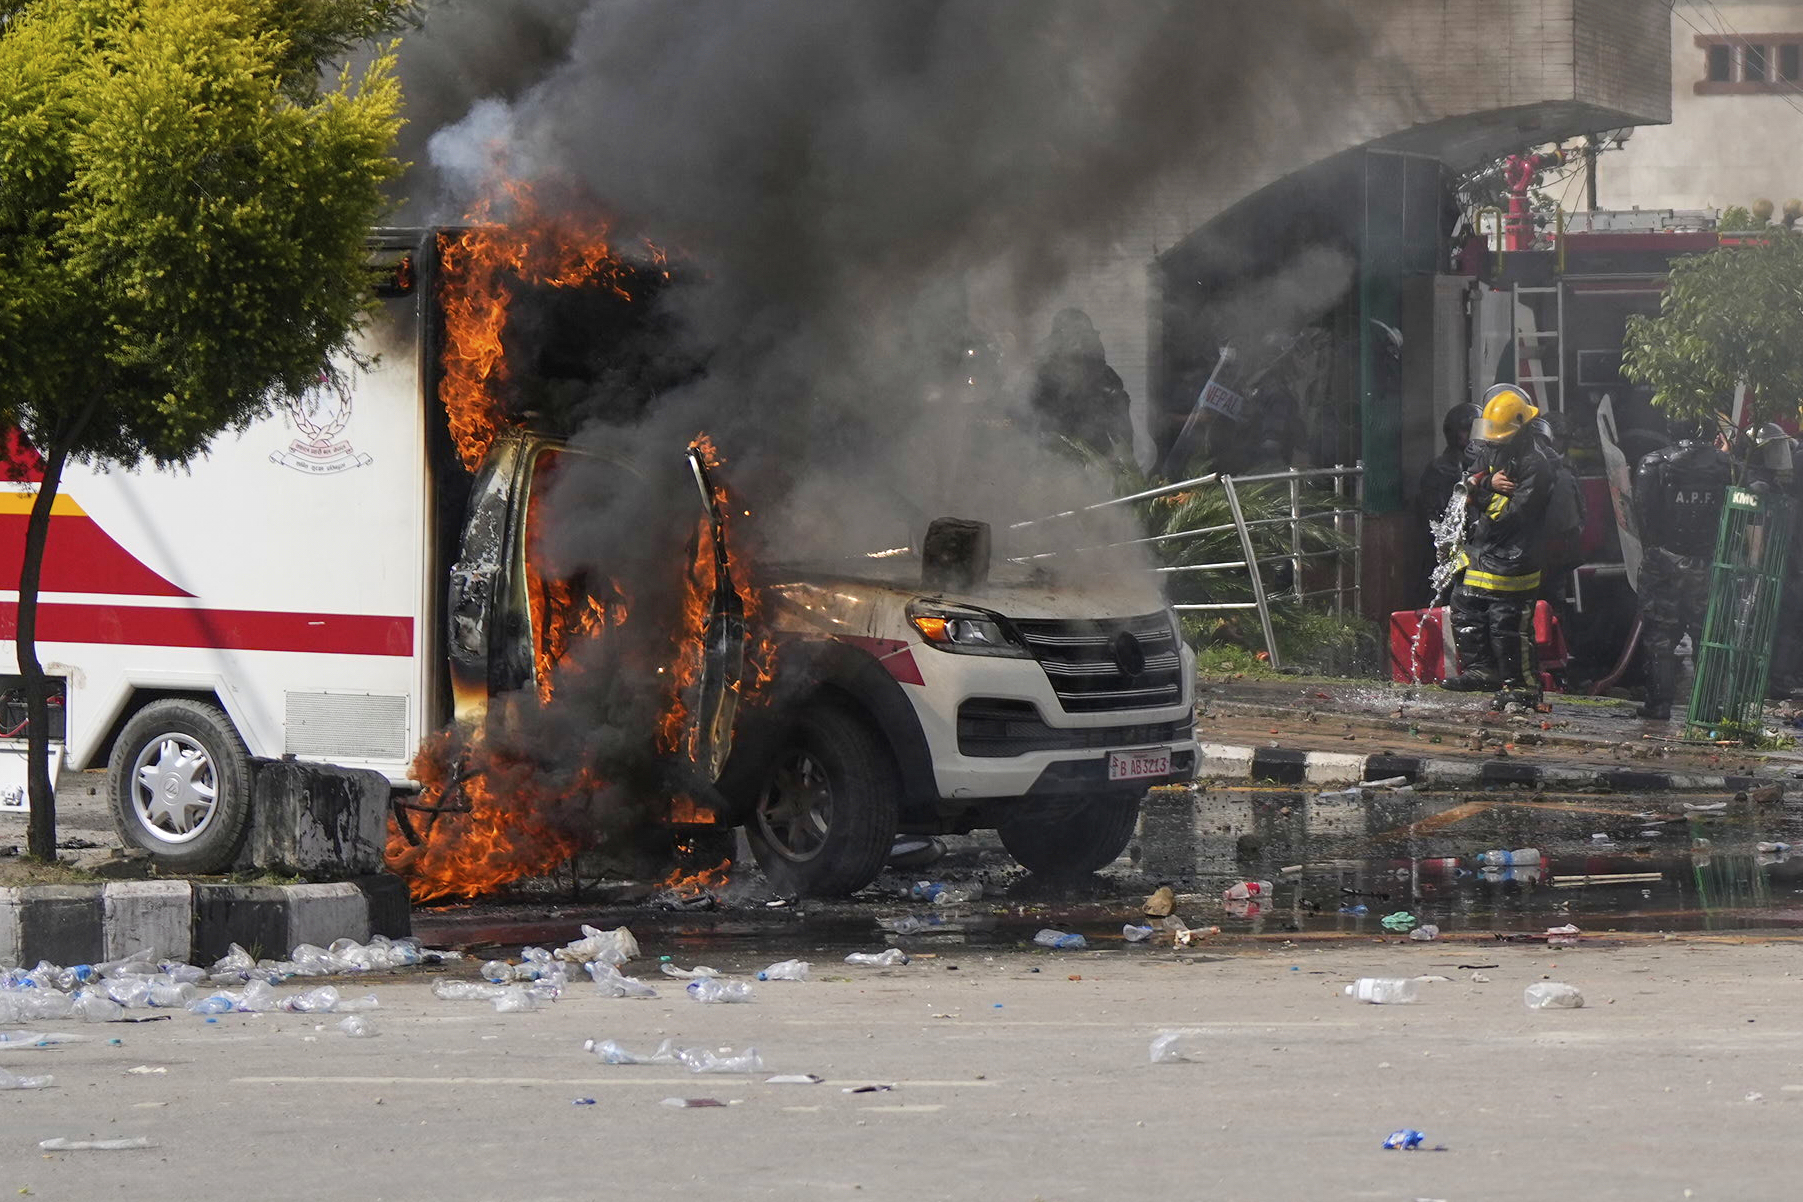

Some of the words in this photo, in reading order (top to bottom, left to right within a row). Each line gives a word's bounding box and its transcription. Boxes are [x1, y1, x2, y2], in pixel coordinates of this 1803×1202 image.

[1676, 491, 1715, 504] A.P.F.
[1732, 491, 1758, 507] KMC
[1120, 761, 1127, 776] B
